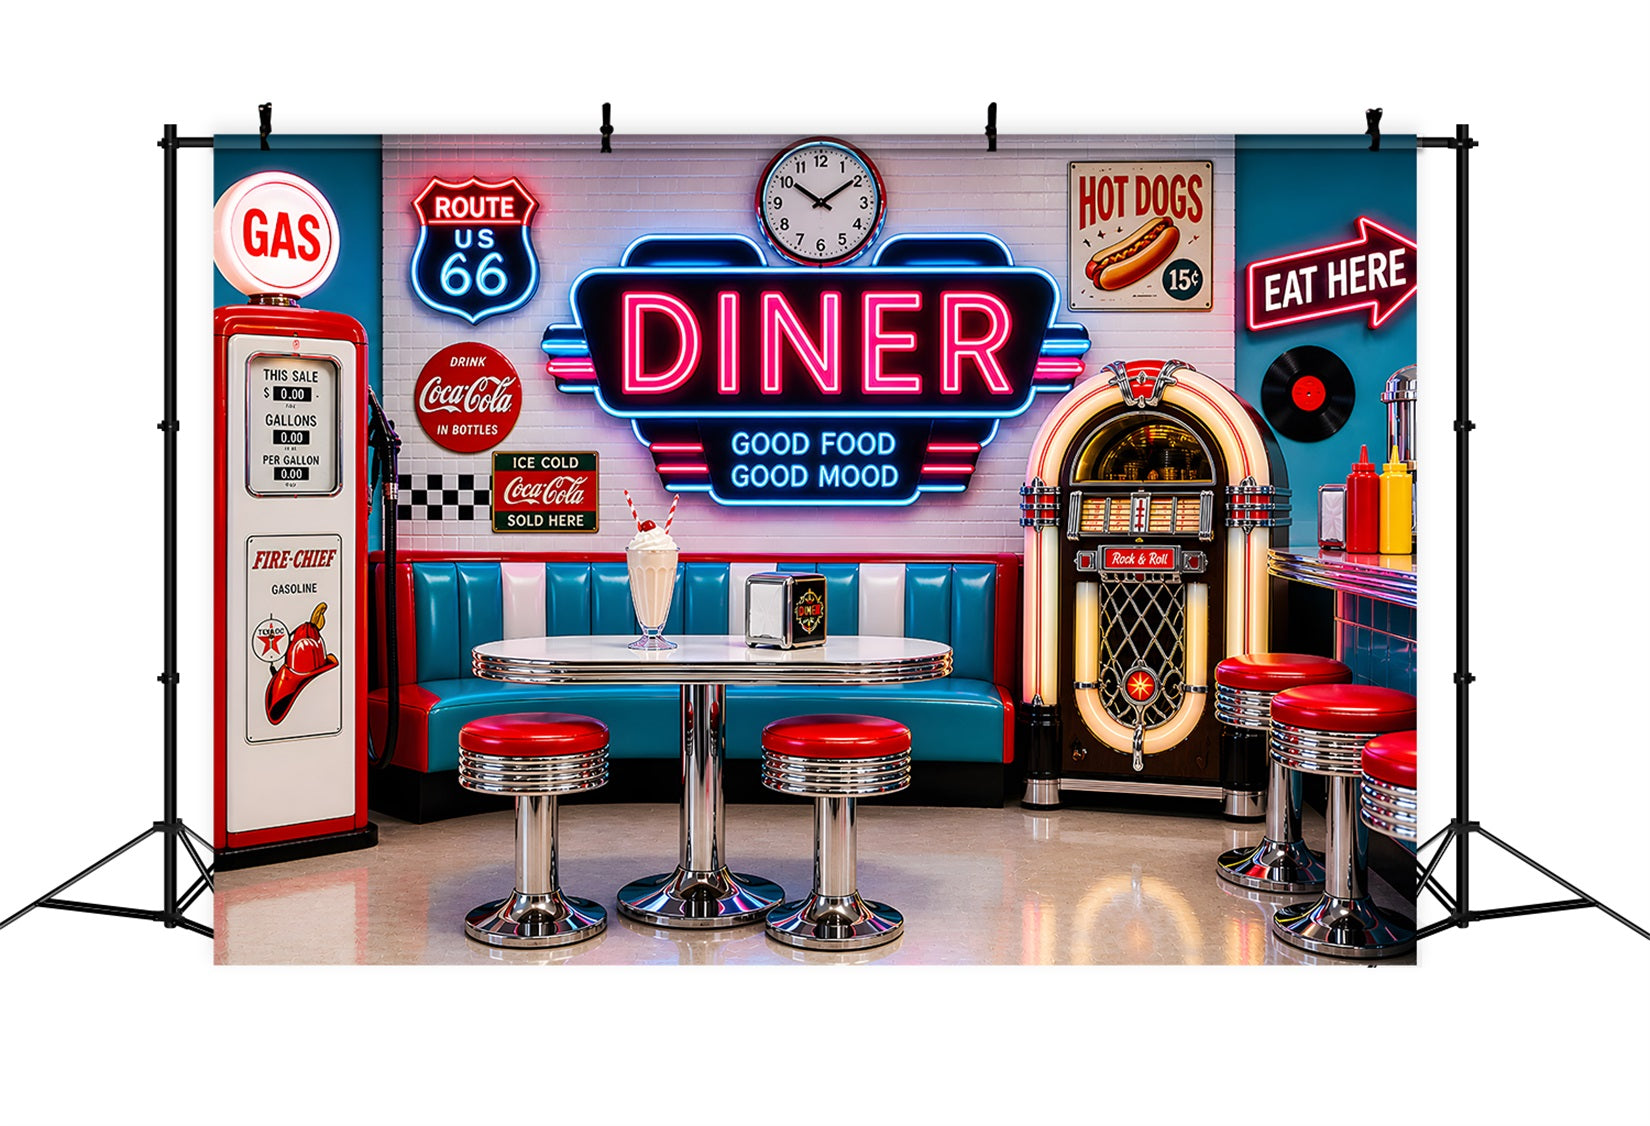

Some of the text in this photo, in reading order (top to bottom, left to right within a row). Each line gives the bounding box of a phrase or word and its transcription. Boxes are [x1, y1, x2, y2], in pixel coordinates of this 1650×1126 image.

[796, 161, 805, 173] 11
[814, 155, 828, 167] 12
[840, 161, 844, 173] 1
[780, 176, 793, 188] 10
[854, 175, 862, 187] 2
[435, 197, 514, 219] ROUTE
[773, 197, 782, 209] 9
[860, 196, 868, 209] 3
[1079, 174, 1203, 231] HOT DOGS
[780, 218, 789, 230] 8
[853, 218, 861, 230] 4
[242, 208, 321, 262] GAS
[796, 233, 804, 245] 7
[838, 233, 846, 245] 5
[816, 239, 825, 251] 6
[440, 253, 508, 297] 66
[1169, 268, 1199, 291] 15¢
[1264, 248, 1407, 312] EAT HERE
[621, 290, 1013, 394] DINER
[450, 356, 487, 367] DRINK
[263, 368, 318, 383] THIS SALE
[263, 386, 305, 400] $ 0.00
[265, 413, 317, 427] GALLONS
[437, 424, 498, 435] IN BOTTLES
[280, 432, 303, 443] 0.00
[731, 432, 896, 456] GOOD FOOD
[262, 455, 319, 466] PER GALLON
[513, 456, 579, 469] ICE COLD
[281, 469, 303, 479] 0.00
[731, 464, 899, 488] GOOD MOOD
[507, 514, 584, 527] SOLD HERE
[252, 549, 337, 570] FIRE-CHIEF
[1112, 552, 1168, 565] Rock & Roll
[271, 583, 318, 595] GASOLINE
